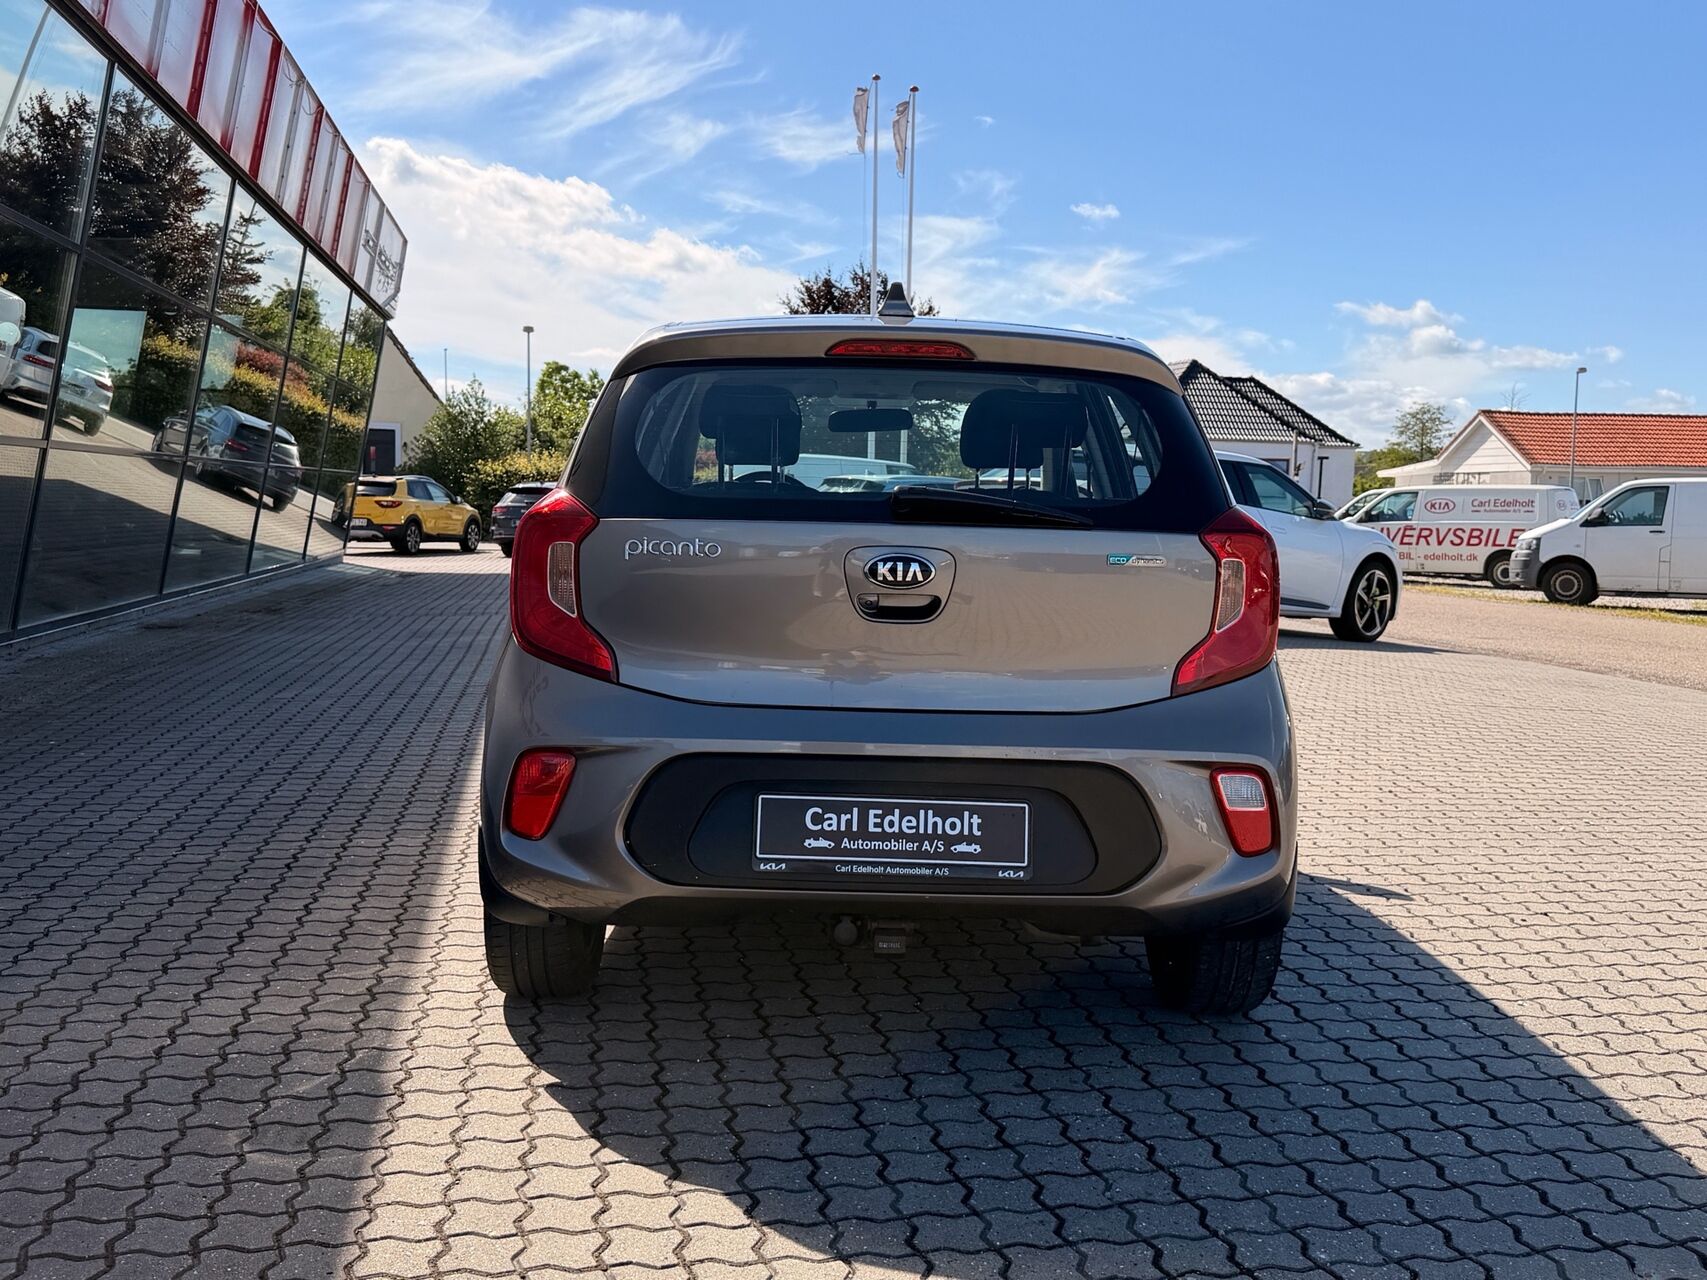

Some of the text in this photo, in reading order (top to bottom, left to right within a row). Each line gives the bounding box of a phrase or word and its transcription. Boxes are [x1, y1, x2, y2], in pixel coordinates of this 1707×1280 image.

[1471, 498, 1535, 508] Carl Edelholt
[1379, 526, 1532, 547] VERVSBILE
[624, 537, 722, 560] picanto
[1423, 552, 1479, 562] edelholt.dk
[876, 561, 924, 582] KIA
[804, 807, 982, 837] Carl Edelholt
[841, 838, 945, 854] Automobiler A/S
[835, 864, 950, 877] Carl Edelholt Automobiler A/S
